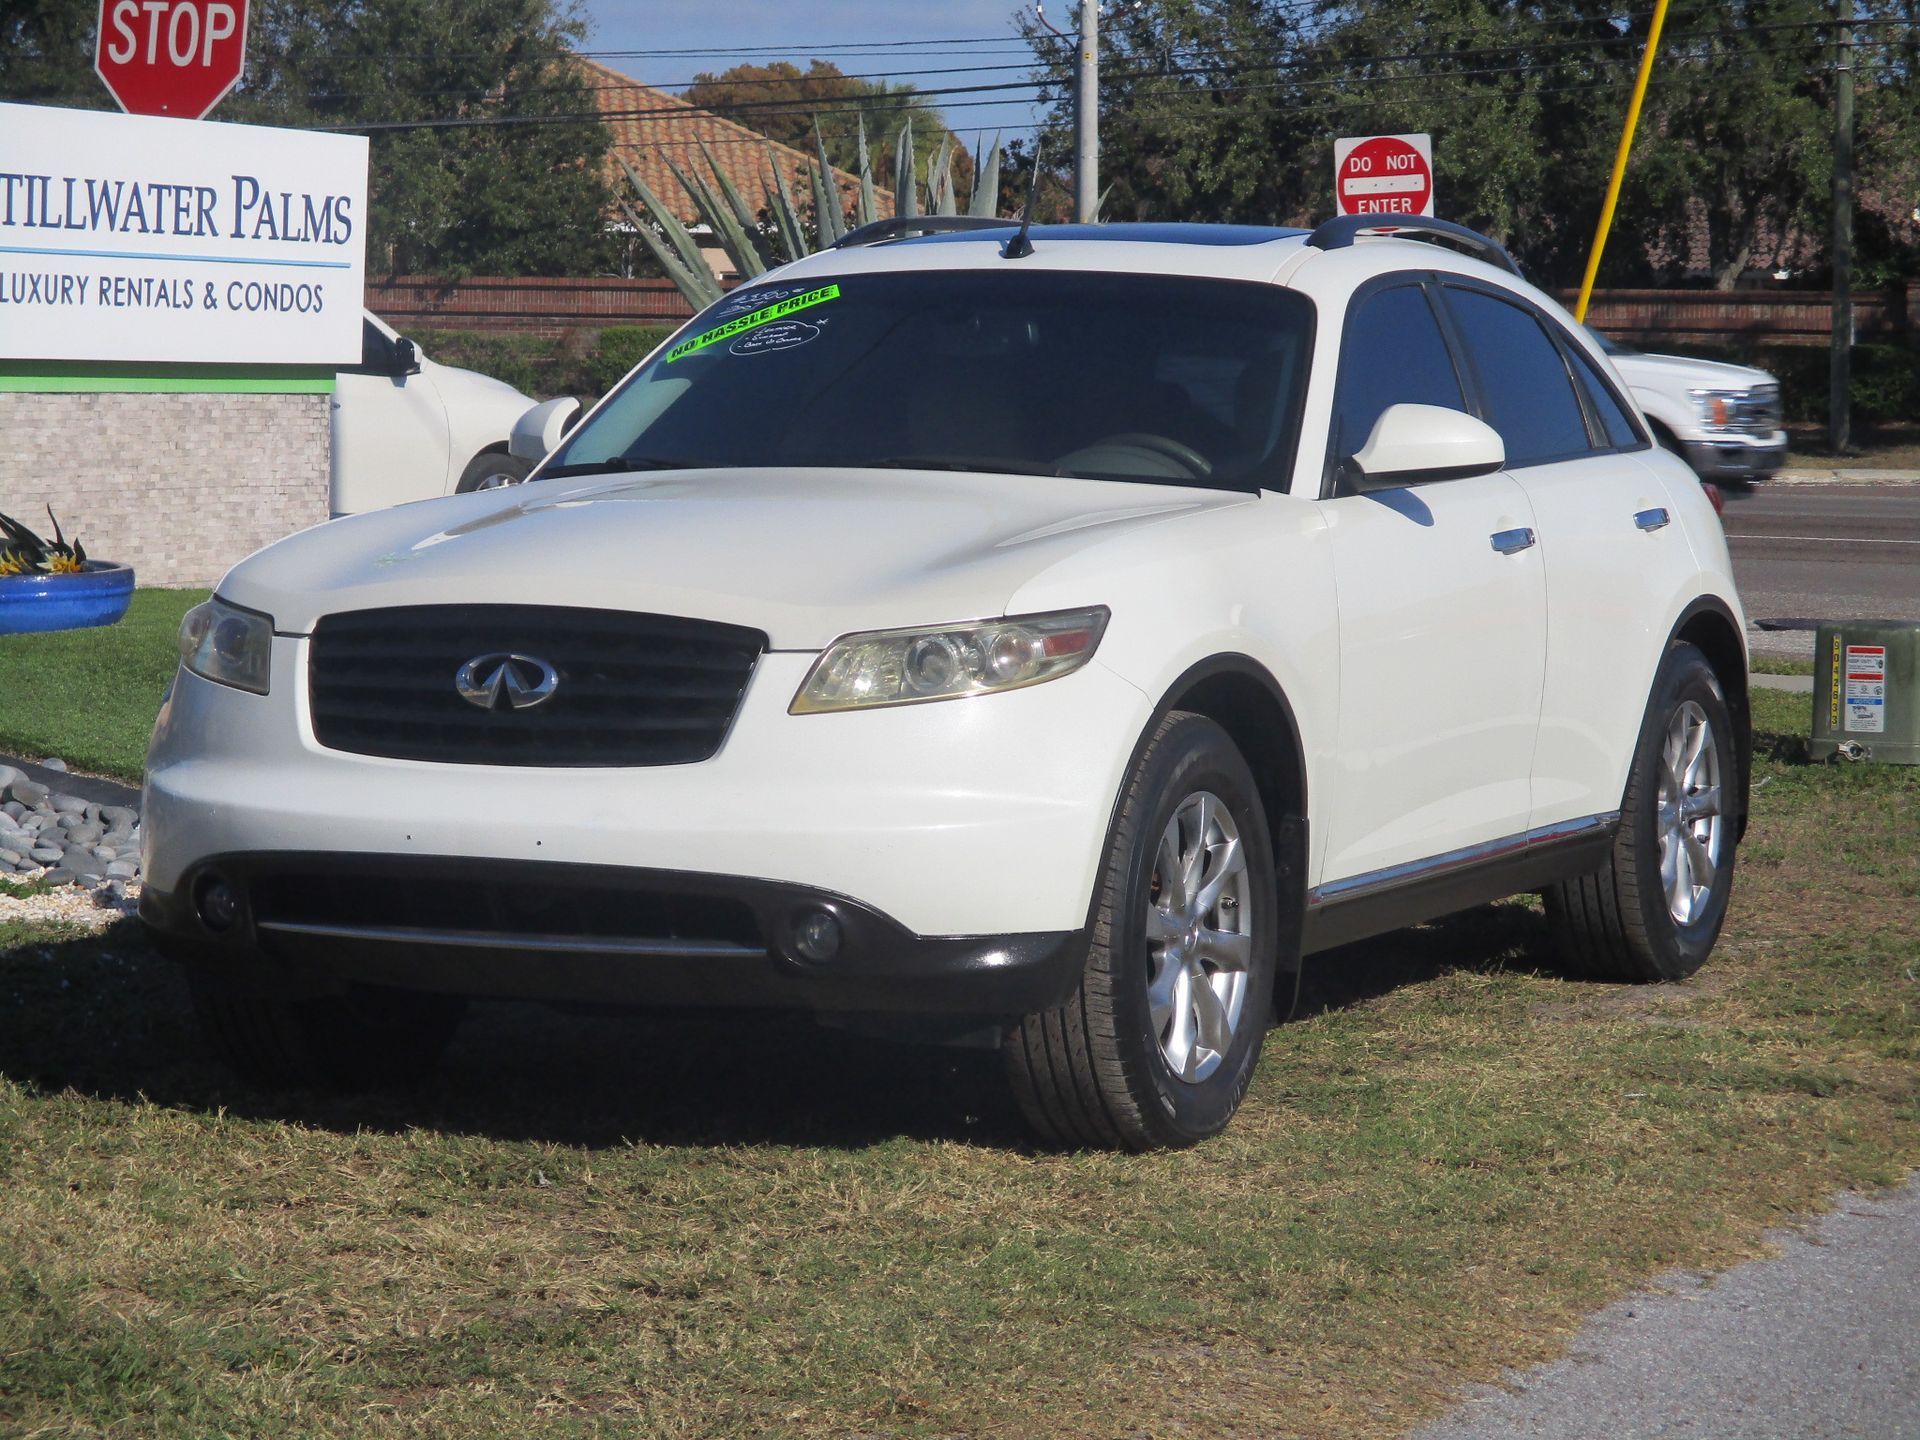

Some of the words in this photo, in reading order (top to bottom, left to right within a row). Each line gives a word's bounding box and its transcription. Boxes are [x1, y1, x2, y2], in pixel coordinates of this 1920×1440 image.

[107, 0, 236, 67] STOP
[1350, 156, 1372, 173] DO
[1386, 153, 1417, 171] NOT
[0, 172, 220, 237] TILLWATER
[229, 174, 353, 245] PALMS
[1358, 197, 1413, 214] ENTER
[0, 272, 90, 306] LUXURY
[98, 275, 195, 309] RENTALS
[203, 281, 219, 311] &
[226, 280, 324, 314] CONDOS
[671, 339, 697, 358] NO
[701, 310, 773, 344] HASSLE
[776, 287, 833, 313] PRICE
